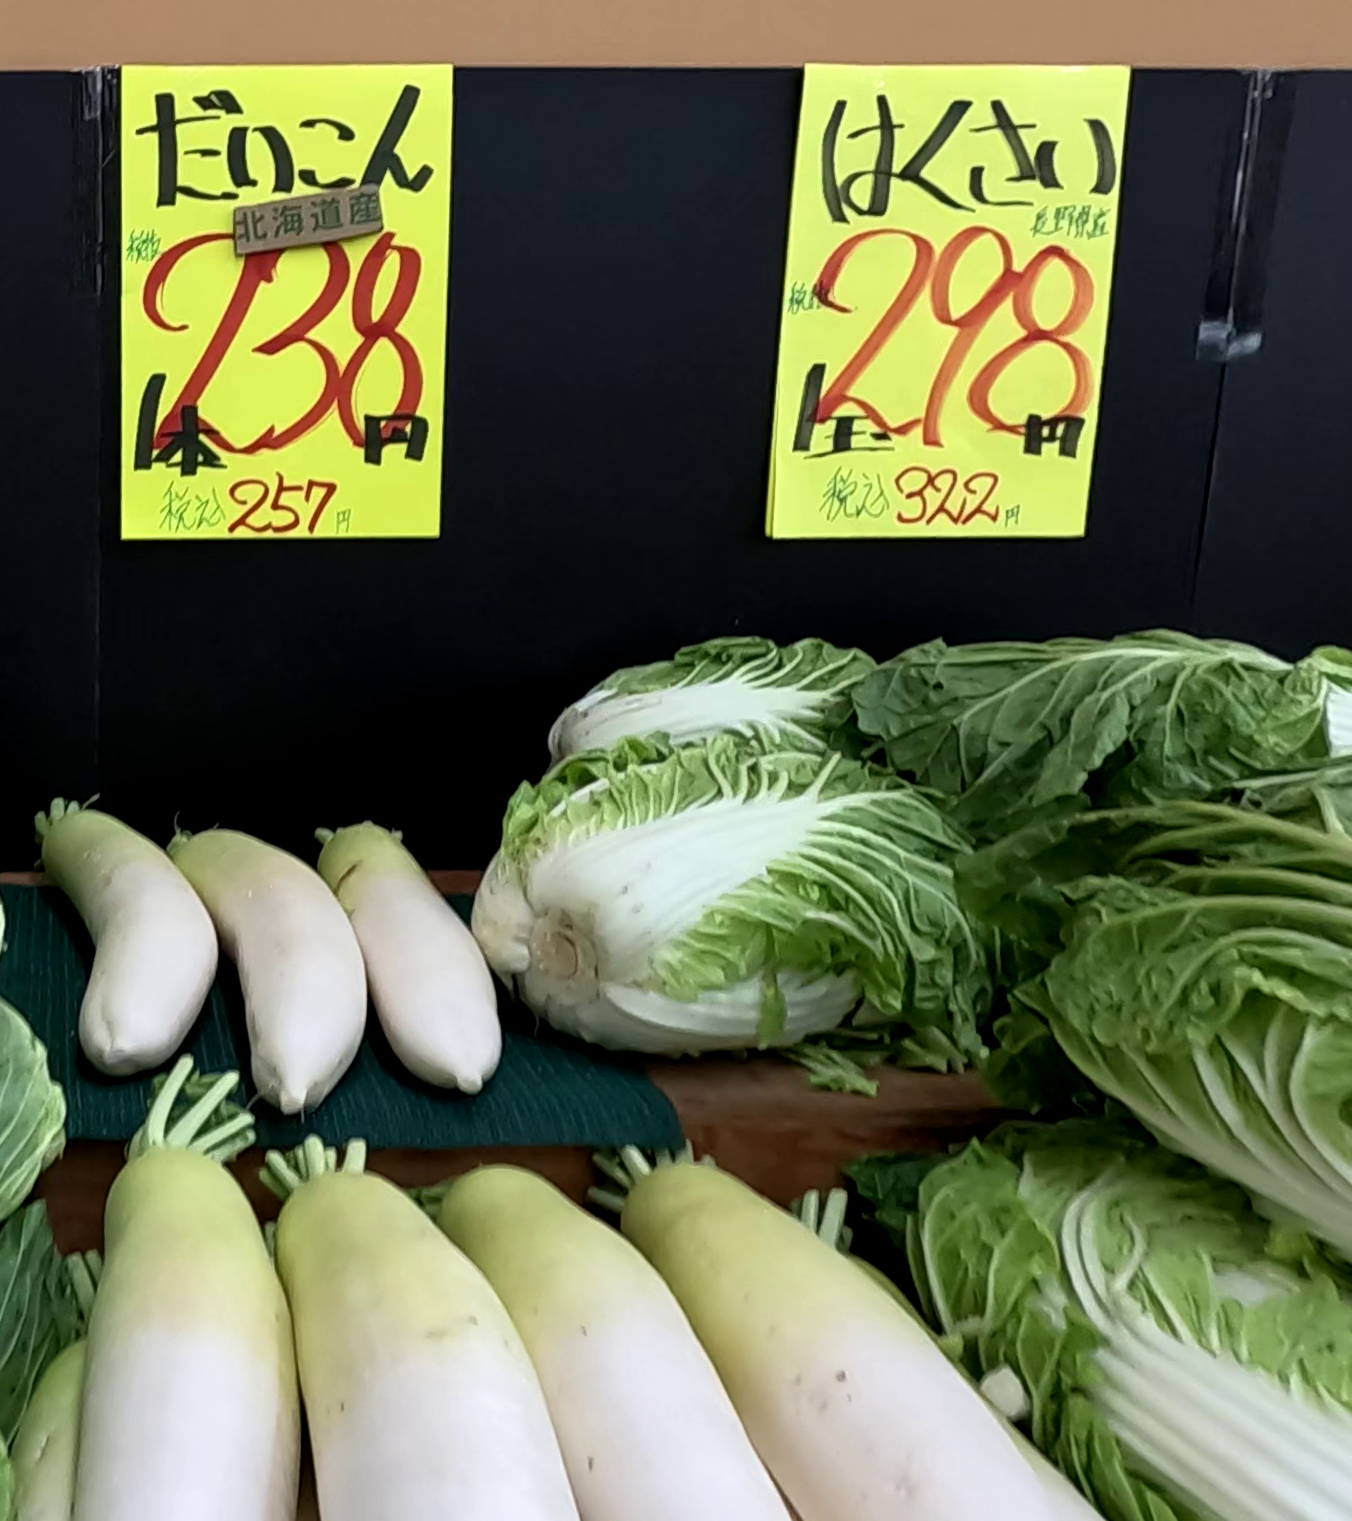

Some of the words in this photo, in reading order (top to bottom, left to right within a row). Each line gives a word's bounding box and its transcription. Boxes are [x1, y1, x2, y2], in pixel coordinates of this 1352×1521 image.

[135, 84, 434, 208] だいこん
[821, 94, 1117, 225] はくさい
[235, 192, 381, 243] 北海道産
[143, 232, 424, 455] 238
[818, 225, 1095, 448] 298
